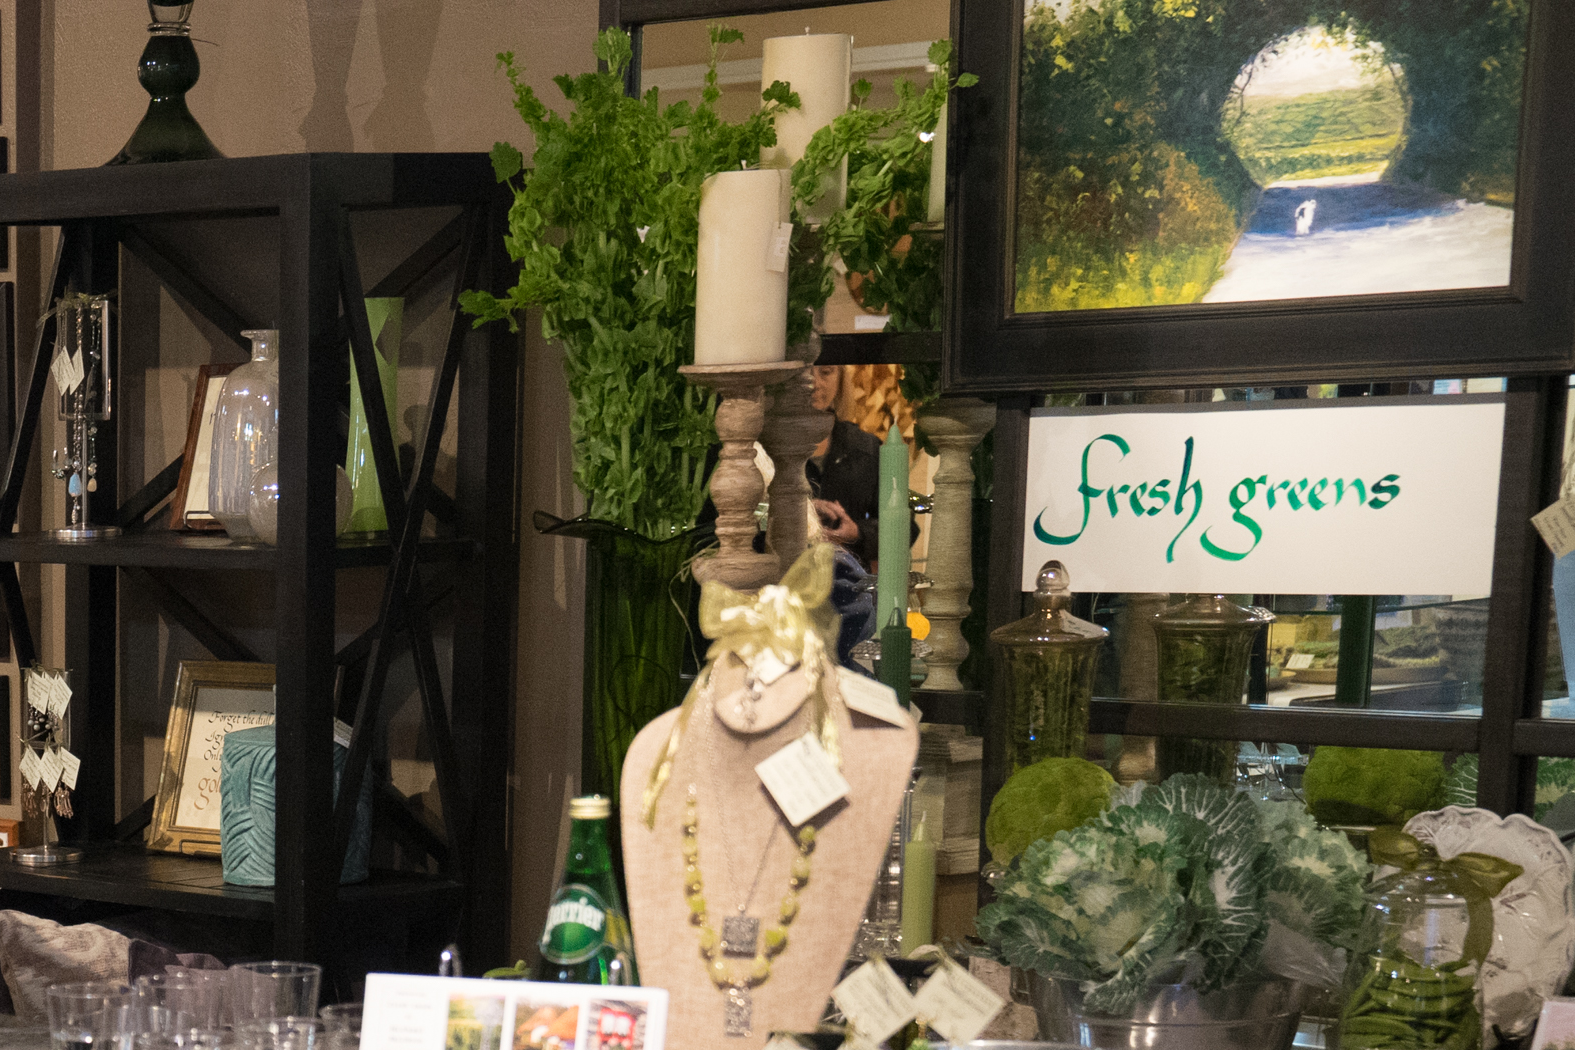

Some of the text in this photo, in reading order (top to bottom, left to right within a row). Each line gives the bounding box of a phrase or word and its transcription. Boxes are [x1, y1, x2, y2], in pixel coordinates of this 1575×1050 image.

[1033, 433, 1203, 563] fresh
[1200, 474, 1401, 561] greens
[208, 710, 241, 733] Forget
[243, 709, 256, 725] the
